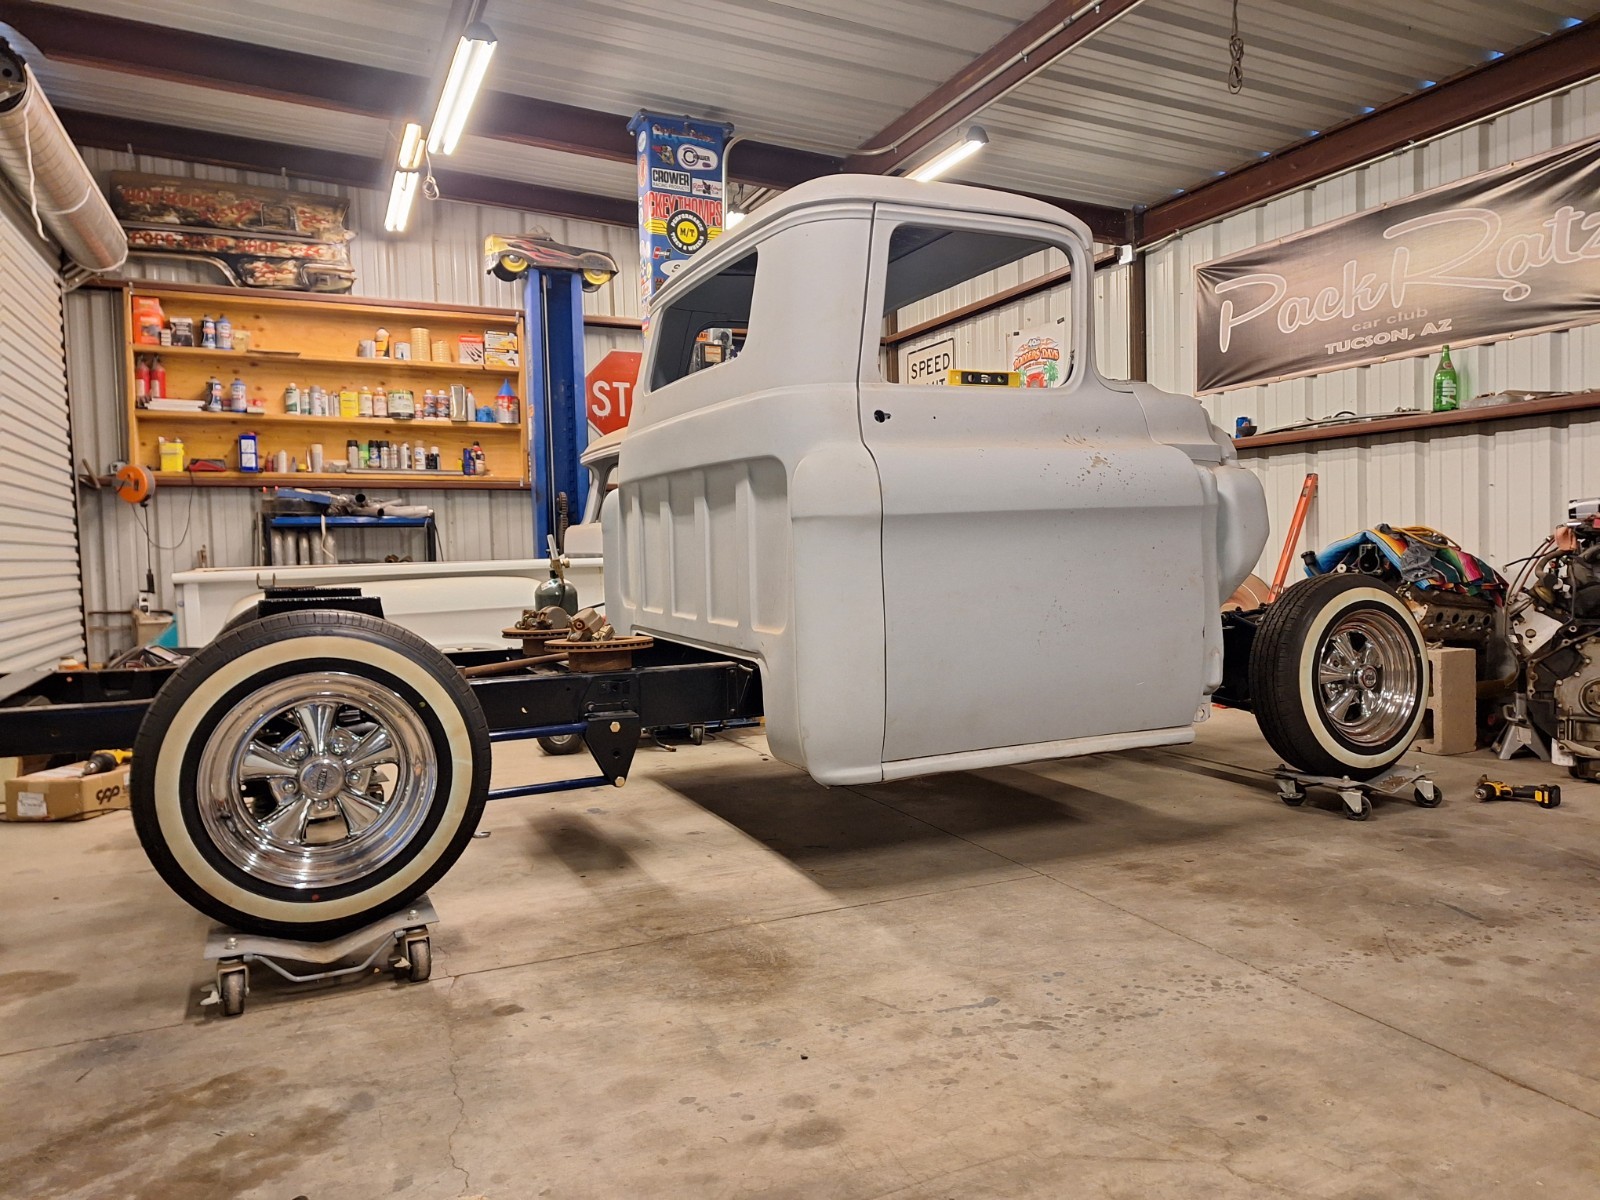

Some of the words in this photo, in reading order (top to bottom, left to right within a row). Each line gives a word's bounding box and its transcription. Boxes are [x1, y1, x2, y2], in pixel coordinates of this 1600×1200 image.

[652, 169, 690, 187] CROWER
[644, 190, 675, 220] CKEY
[677, 195, 723, 227] THOMPS
[670, 213, 705, 232] PERFORMANCE
[1214, 259, 1389, 354] Pack
[1351, 319, 1381, 332] car
[1386, 308, 1429, 324] club
[1324, 327, 1416, 355] TUCSON,
[1420, 318, 1453, 337] AZ
[910, 352, 951, 380] SPEED
[591, 379, 631, 417] ST
[1440, 379, 1457, 405] 7UP
